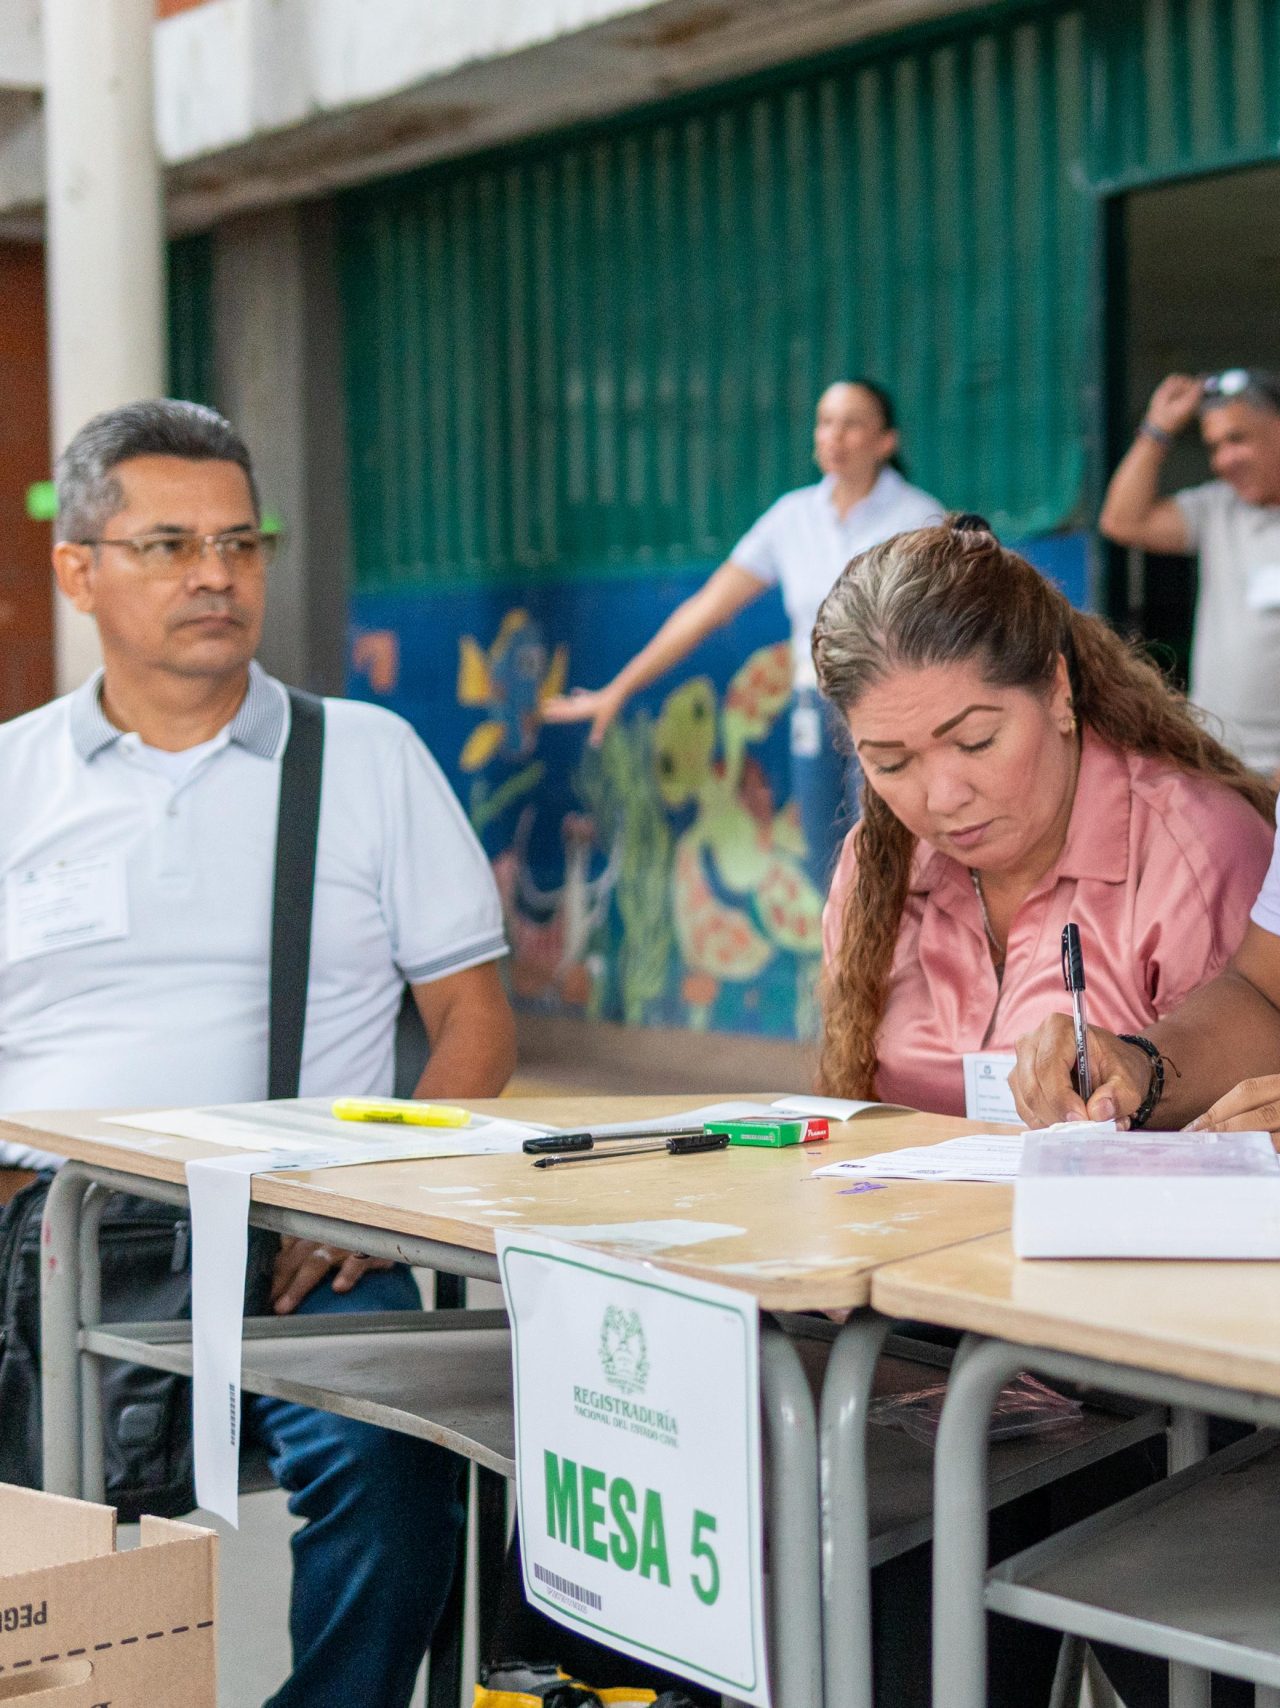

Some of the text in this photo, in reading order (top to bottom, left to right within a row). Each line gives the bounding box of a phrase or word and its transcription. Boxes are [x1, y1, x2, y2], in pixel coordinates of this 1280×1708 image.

[573, 1385, 678, 1434] REGISTRADURÍA
[574, 1405, 610, 1426] NACIONAL
[613, 1417, 628, 1431] DEL
[543, 1449, 720, 1606] MESA 5
